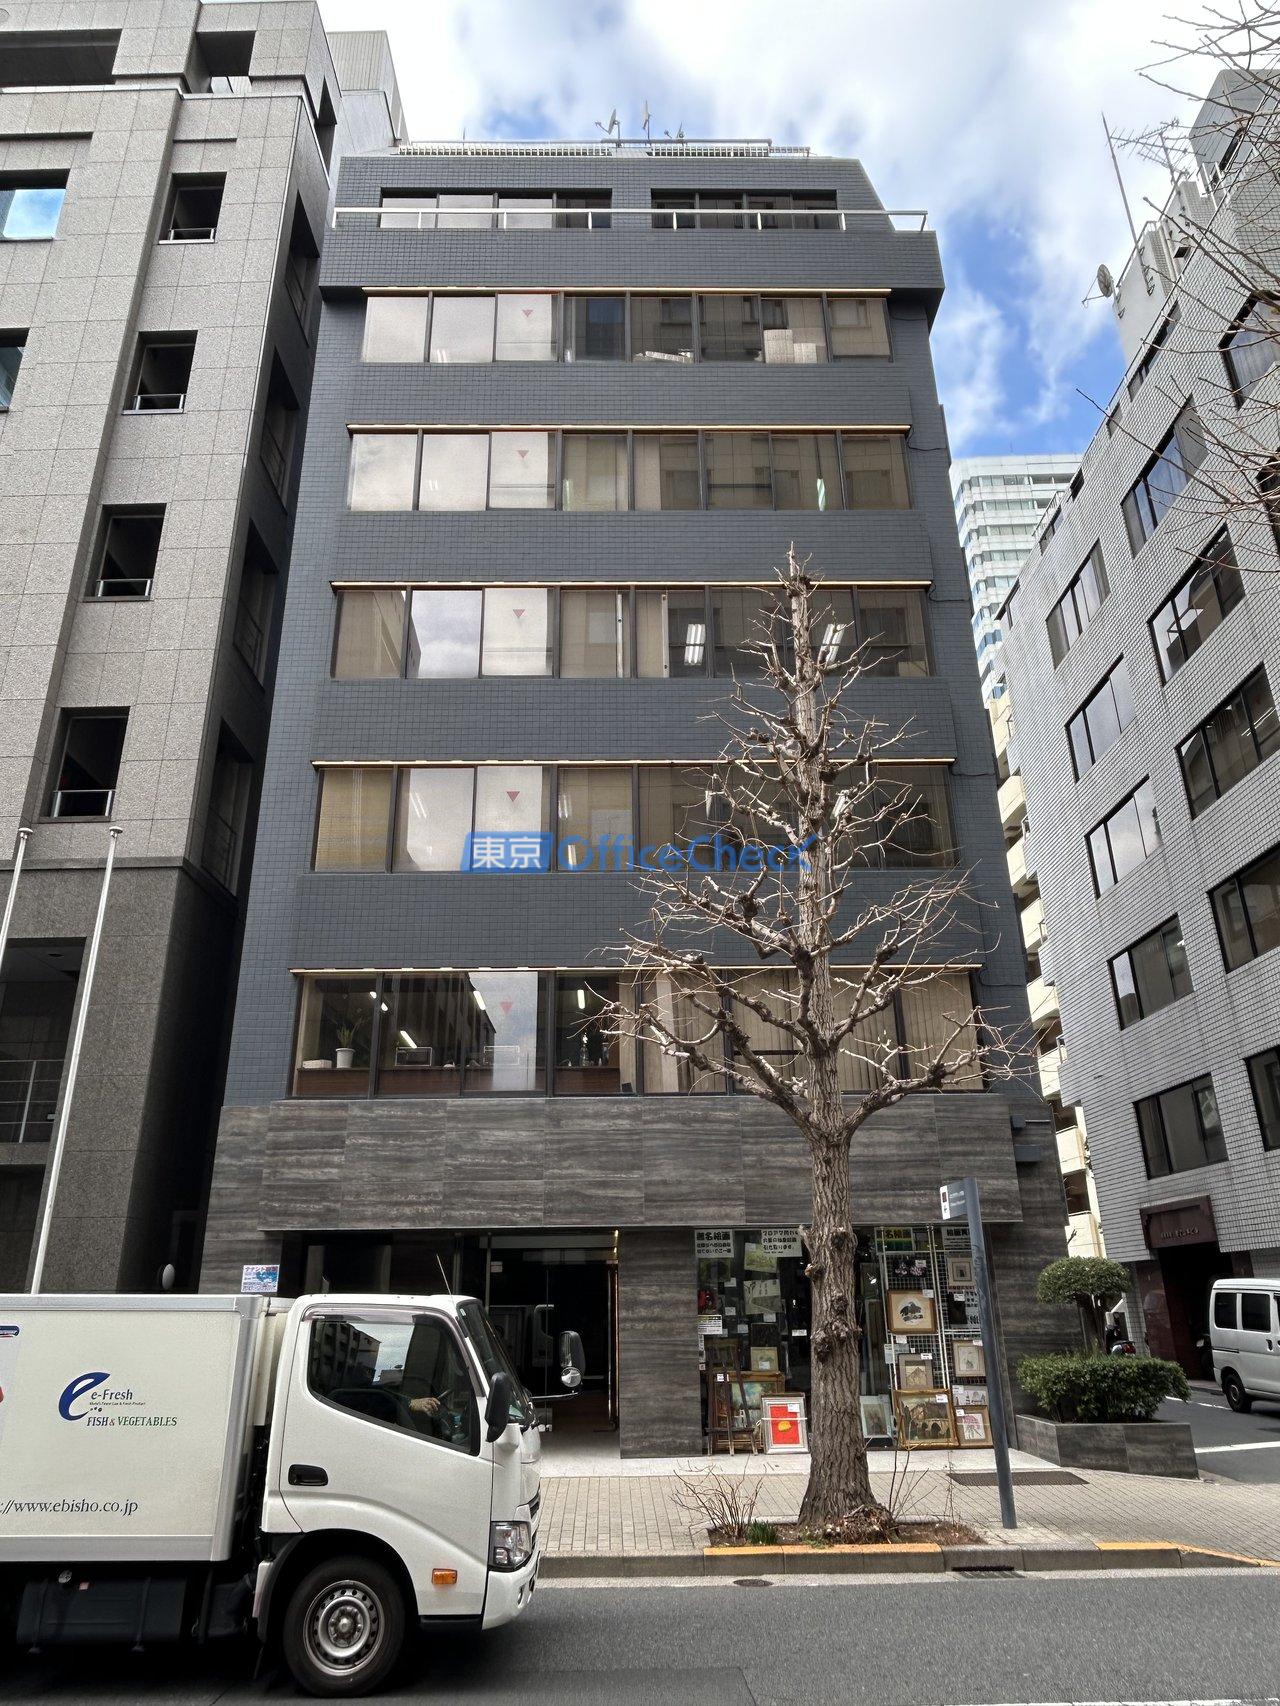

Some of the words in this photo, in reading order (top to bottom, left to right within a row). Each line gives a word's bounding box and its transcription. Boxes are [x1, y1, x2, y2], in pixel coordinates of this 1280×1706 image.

[91, 1388, 133, 1400] e-Fresh
[86, 1416, 108, 1427] FISH
[109, 1418, 115, 1427] &
[117, 1415, 178, 1427] VEGETABLES
